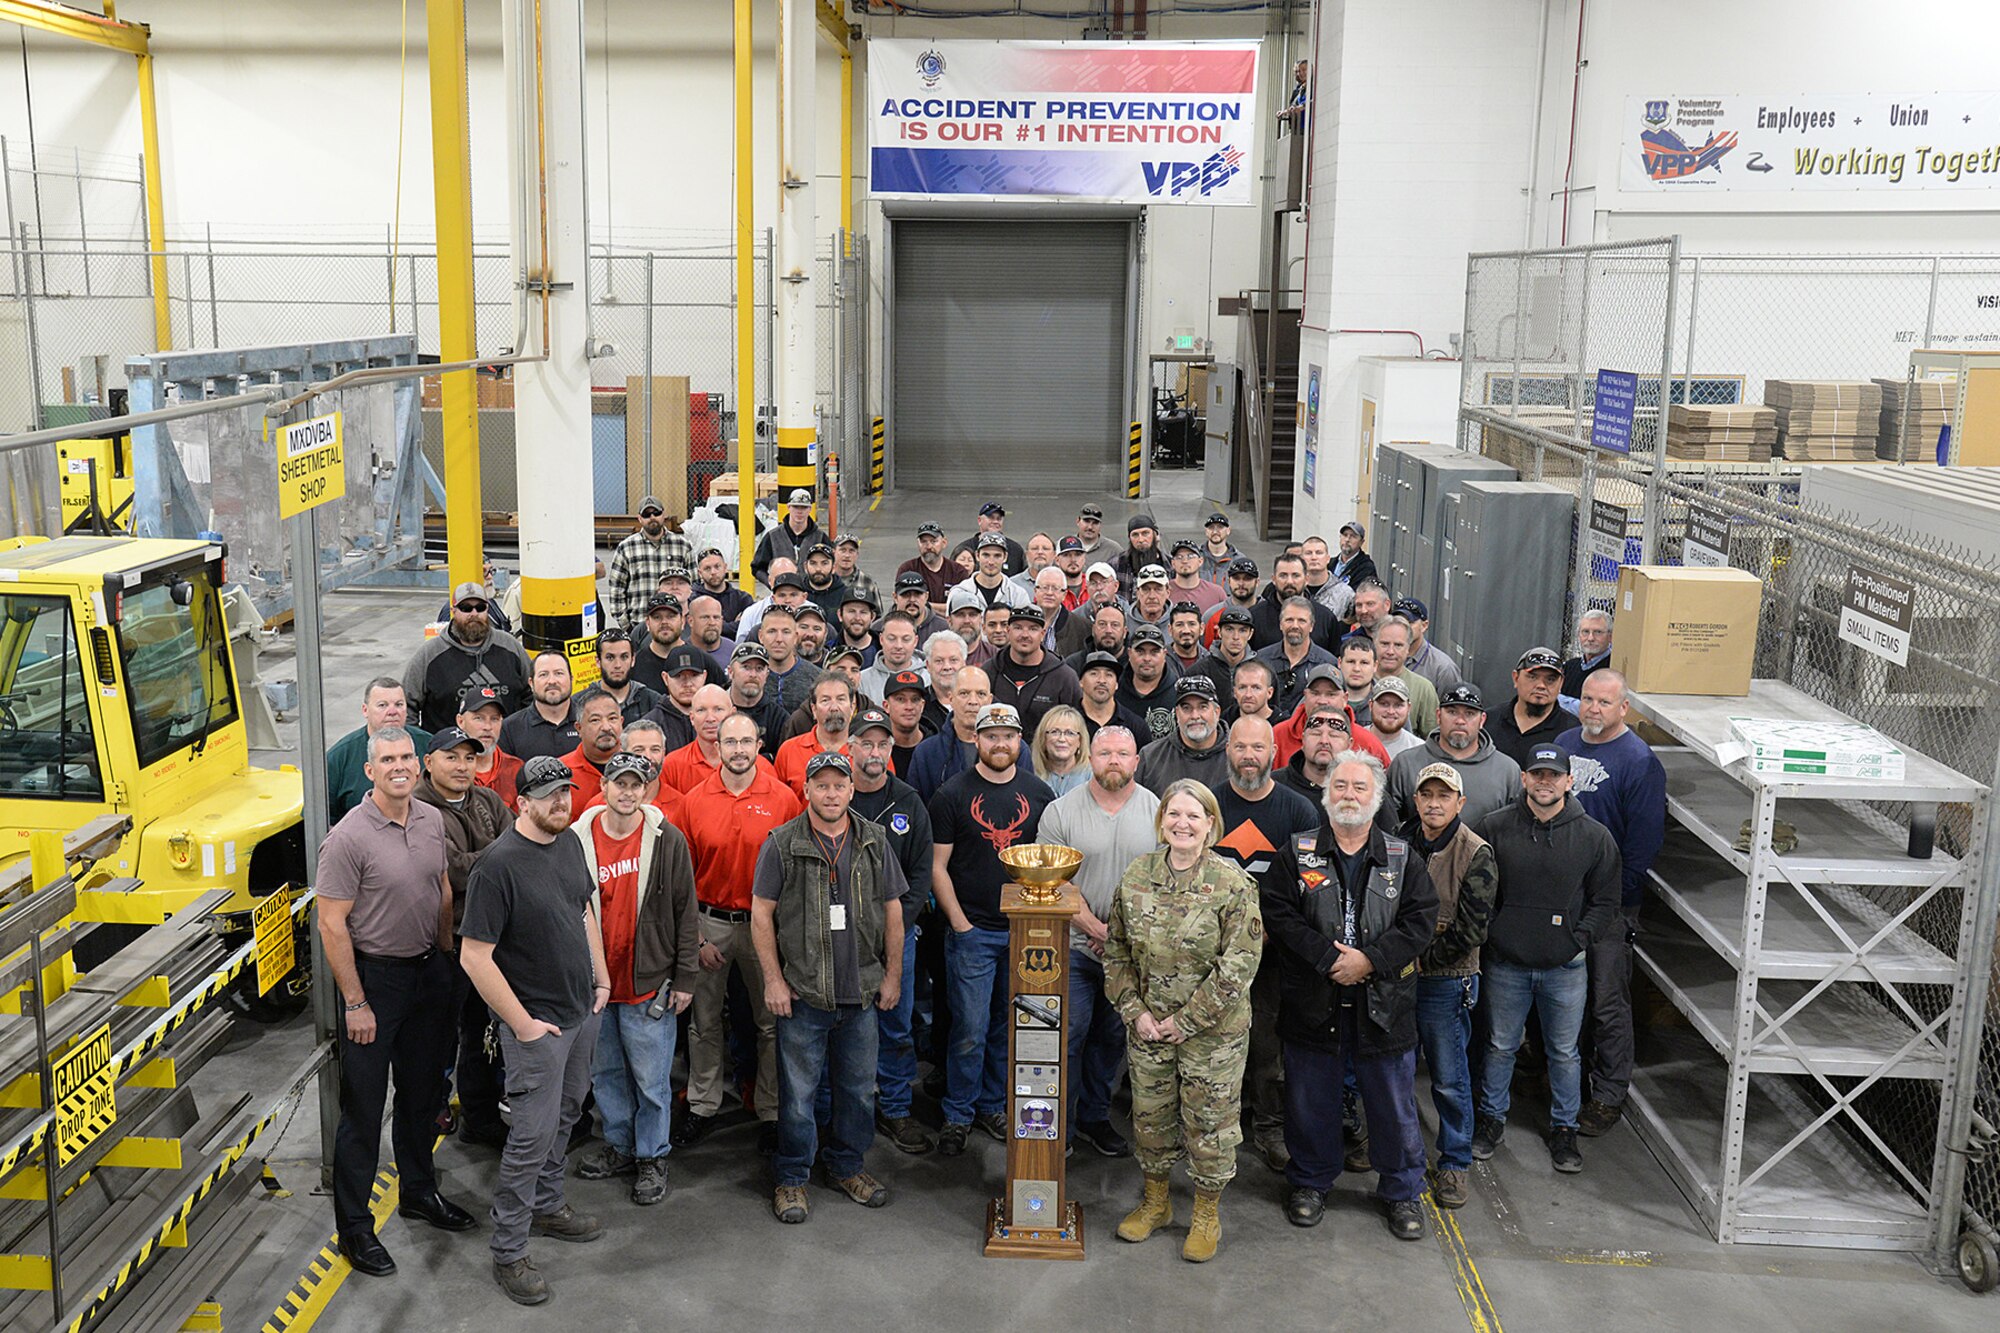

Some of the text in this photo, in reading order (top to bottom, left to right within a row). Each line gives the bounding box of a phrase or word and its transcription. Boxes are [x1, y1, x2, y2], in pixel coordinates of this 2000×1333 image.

[881, 99, 1241, 121] ACCIDENT PREVENTION
[1677, 109, 1724, 117] Protection
[1678, 100, 1722, 109] Voluntary
[1757, 106, 1836, 134] Employees
[1890, 104, 1929, 127] Union
[900, 123, 1222, 143] IS OUR #1 INTENTION
[1676, 118, 1715, 127] Program
[1141, 158, 1235, 197] VPP
[1641, 153, 1697, 175] VPP
[1794, 147, 1905, 183] Working
[289, 420, 332, 452] MXDVBA
[281, 446, 341, 482] SHEETMETAL
[300, 476, 326, 503] SHOP
[1690, 508, 1728, 533] Pre-Positioned
[1691, 525, 1722, 548] PM Material
[1851, 570, 1909, 605] Pre-Positioned
[1853, 591, 1900, 622] PM Material
[1846, 618, 1900, 654] SMALL ITEMS
[608, 856, 640, 878] YAMA
[256, 888, 288, 925] CAUTION
[57, 1034, 109, 1100] CAUTION
[61, 1086, 111, 1144] DROP ZONE
